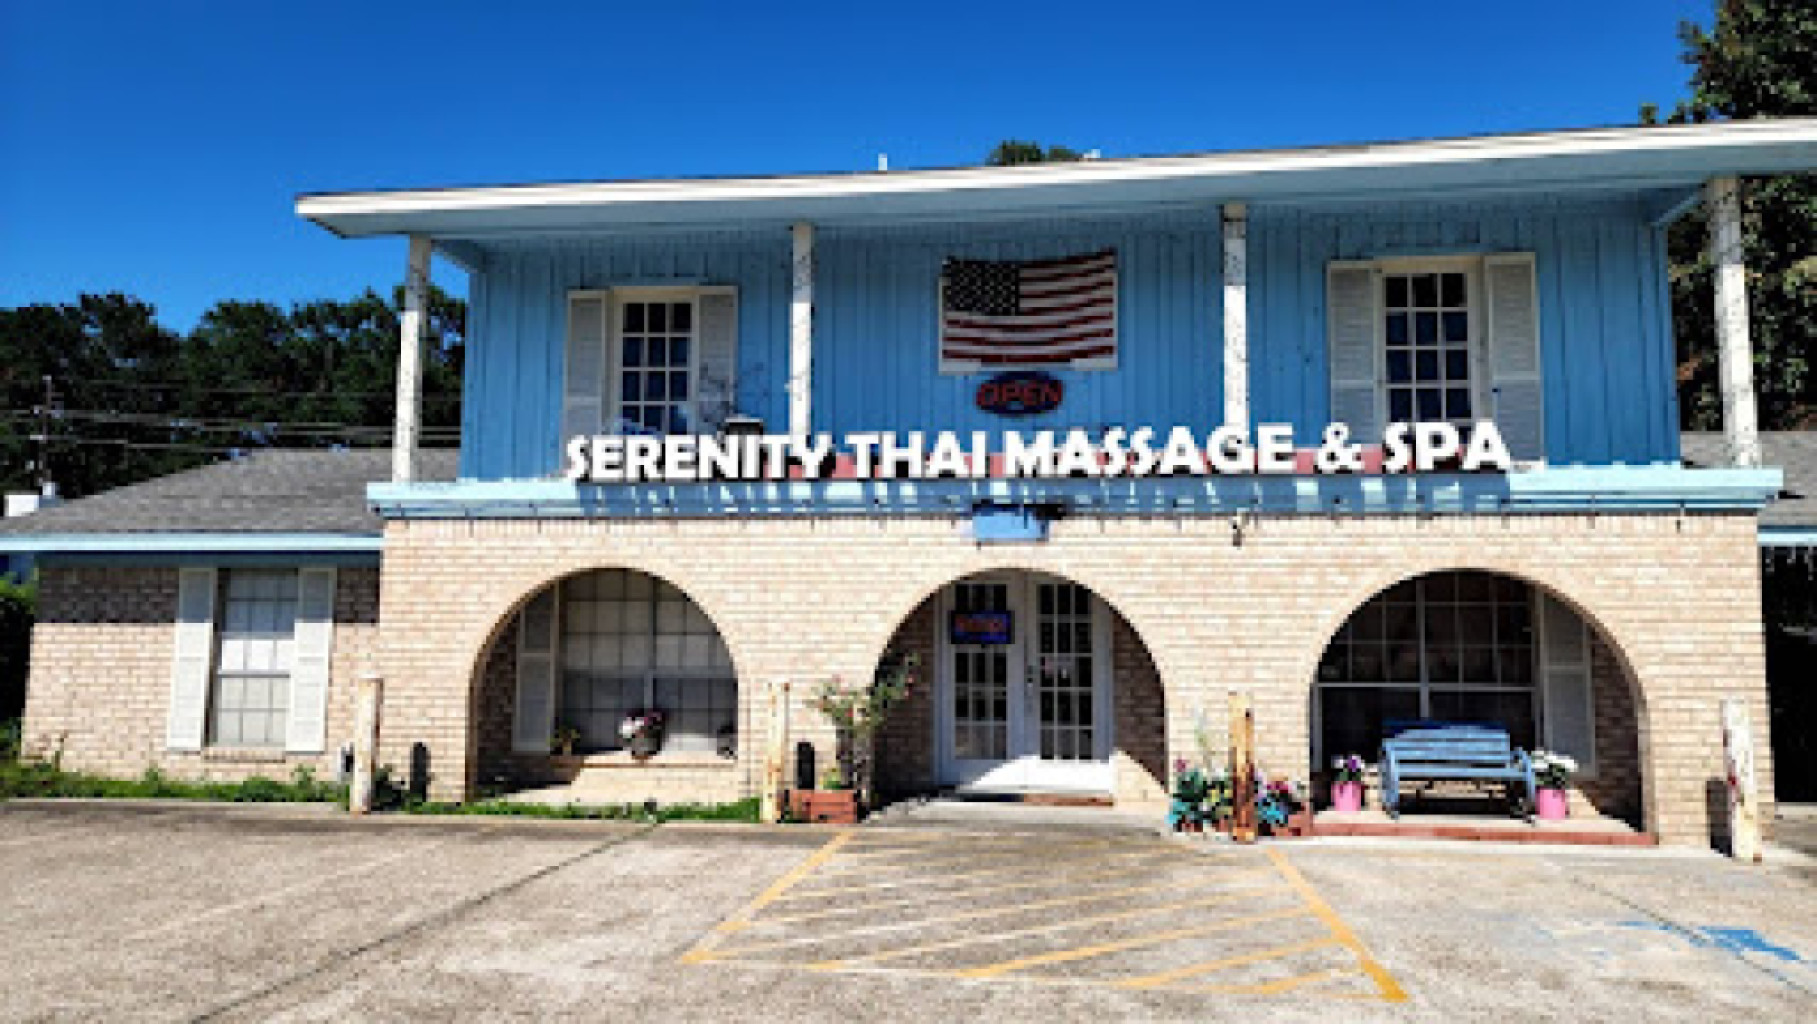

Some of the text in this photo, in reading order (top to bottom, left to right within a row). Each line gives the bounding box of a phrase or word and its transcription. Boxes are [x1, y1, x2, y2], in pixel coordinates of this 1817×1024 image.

[976, 383, 1063, 406] OPEN
[565, 420, 1512, 481] SERENITY THAI MASSAGE & SPA
